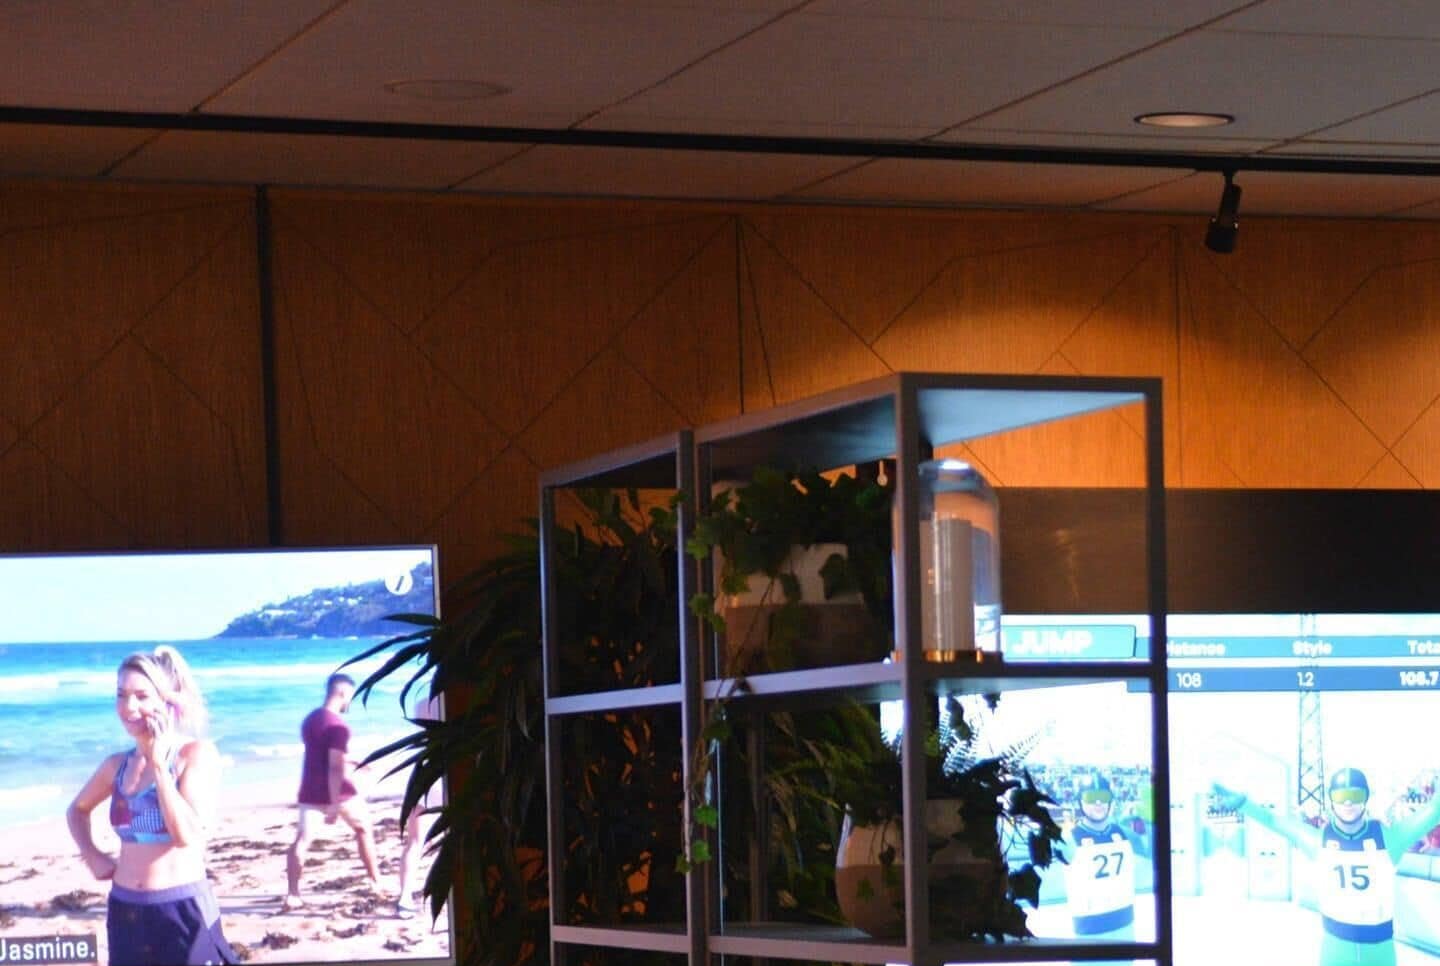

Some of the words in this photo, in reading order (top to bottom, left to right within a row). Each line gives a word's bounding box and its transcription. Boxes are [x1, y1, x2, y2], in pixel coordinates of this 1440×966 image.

[1011, 629, 1093, 655] JUMP
[1166, 640, 1226, 658] istance
[1292, 638, 1333, 657] Style
[1175, 671, 1203, 689] 108
[1092, 851, 1124, 879] 27
[1333, 864, 1370, 891] 15
[0, 936, 95, 961] Jasmine.
